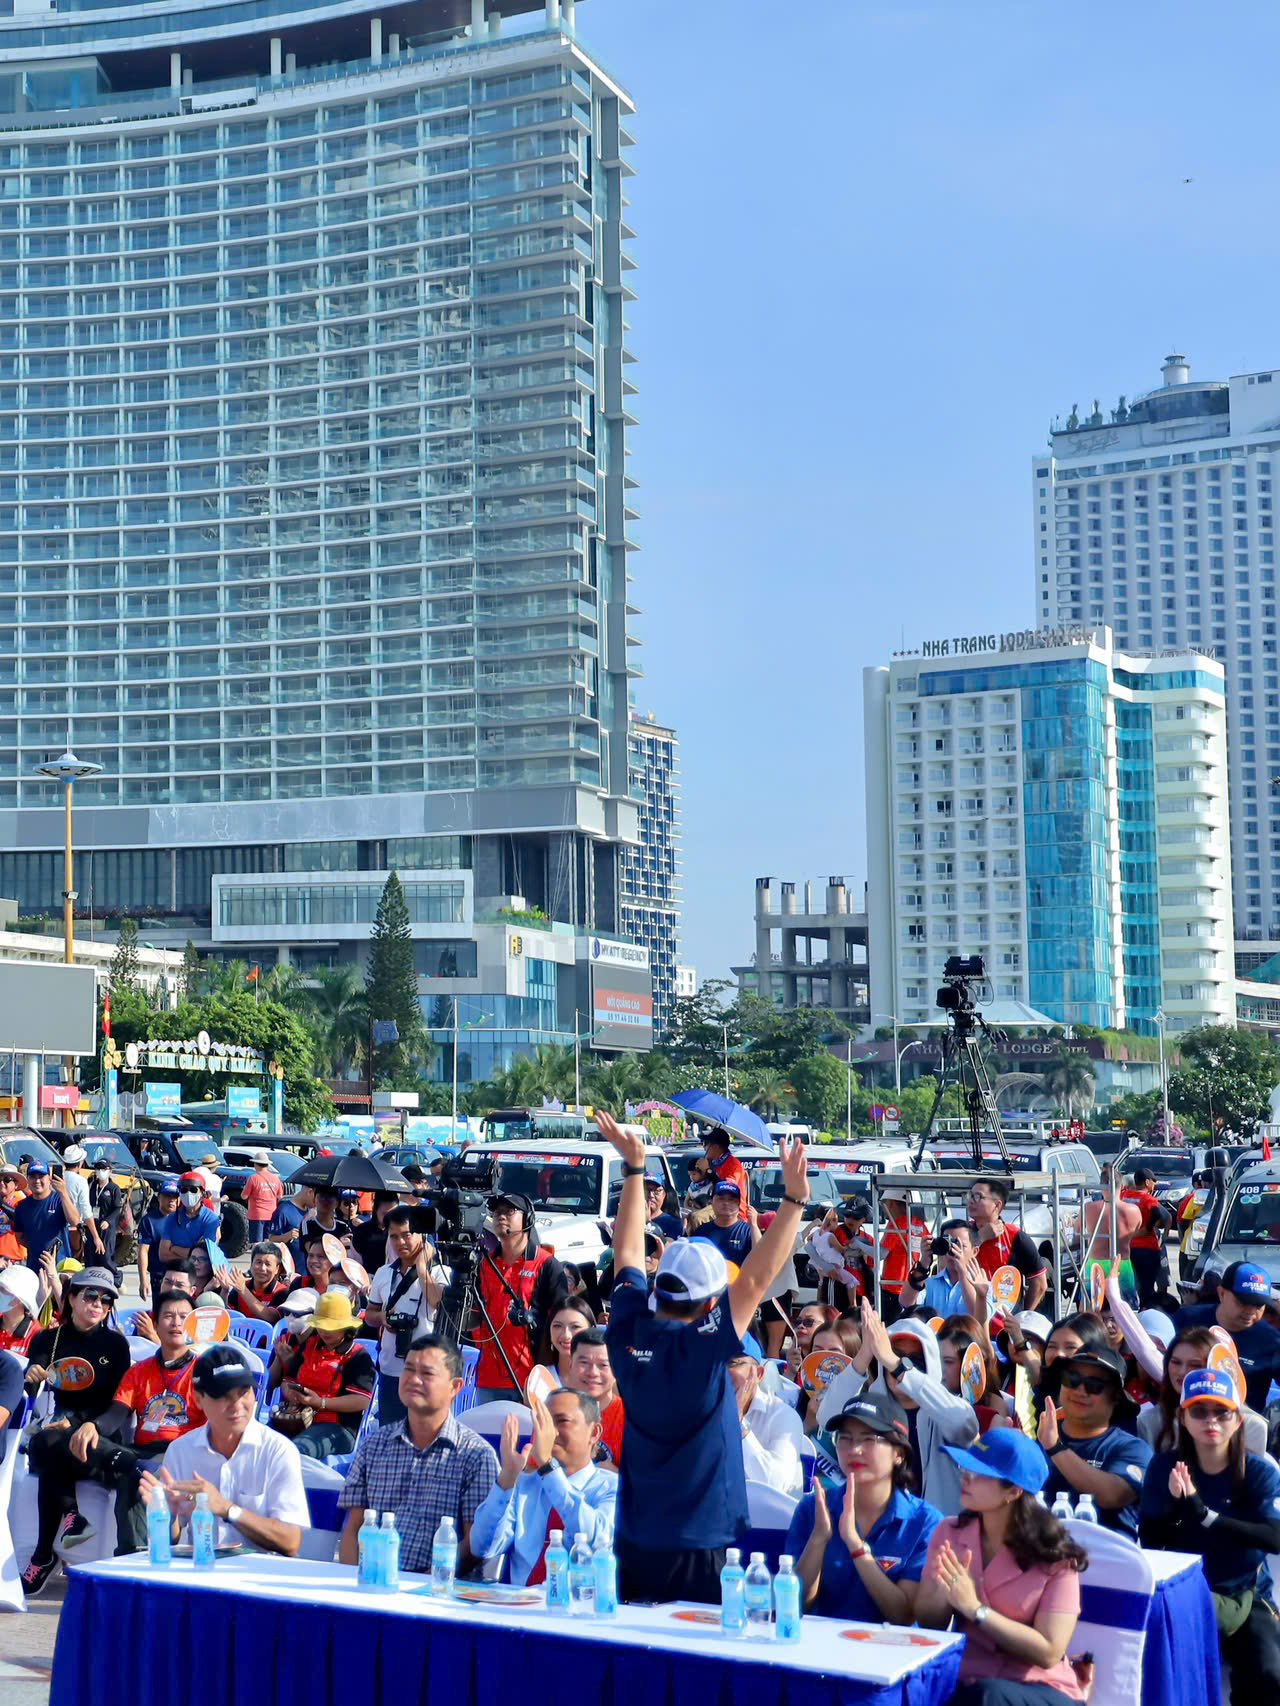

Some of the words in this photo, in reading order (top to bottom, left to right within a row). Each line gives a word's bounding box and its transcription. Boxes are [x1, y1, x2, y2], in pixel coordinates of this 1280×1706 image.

[923, 640, 948, 657] NHA
[953, 635, 996, 654] TRANG
[1003, 1043, 1053, 1055] LODGE
[858, 1165, 873, 1174] 403
[1239, 1186, 1260, 1195] 408
[1189, 1380, 1228, 1391] SAILUN
